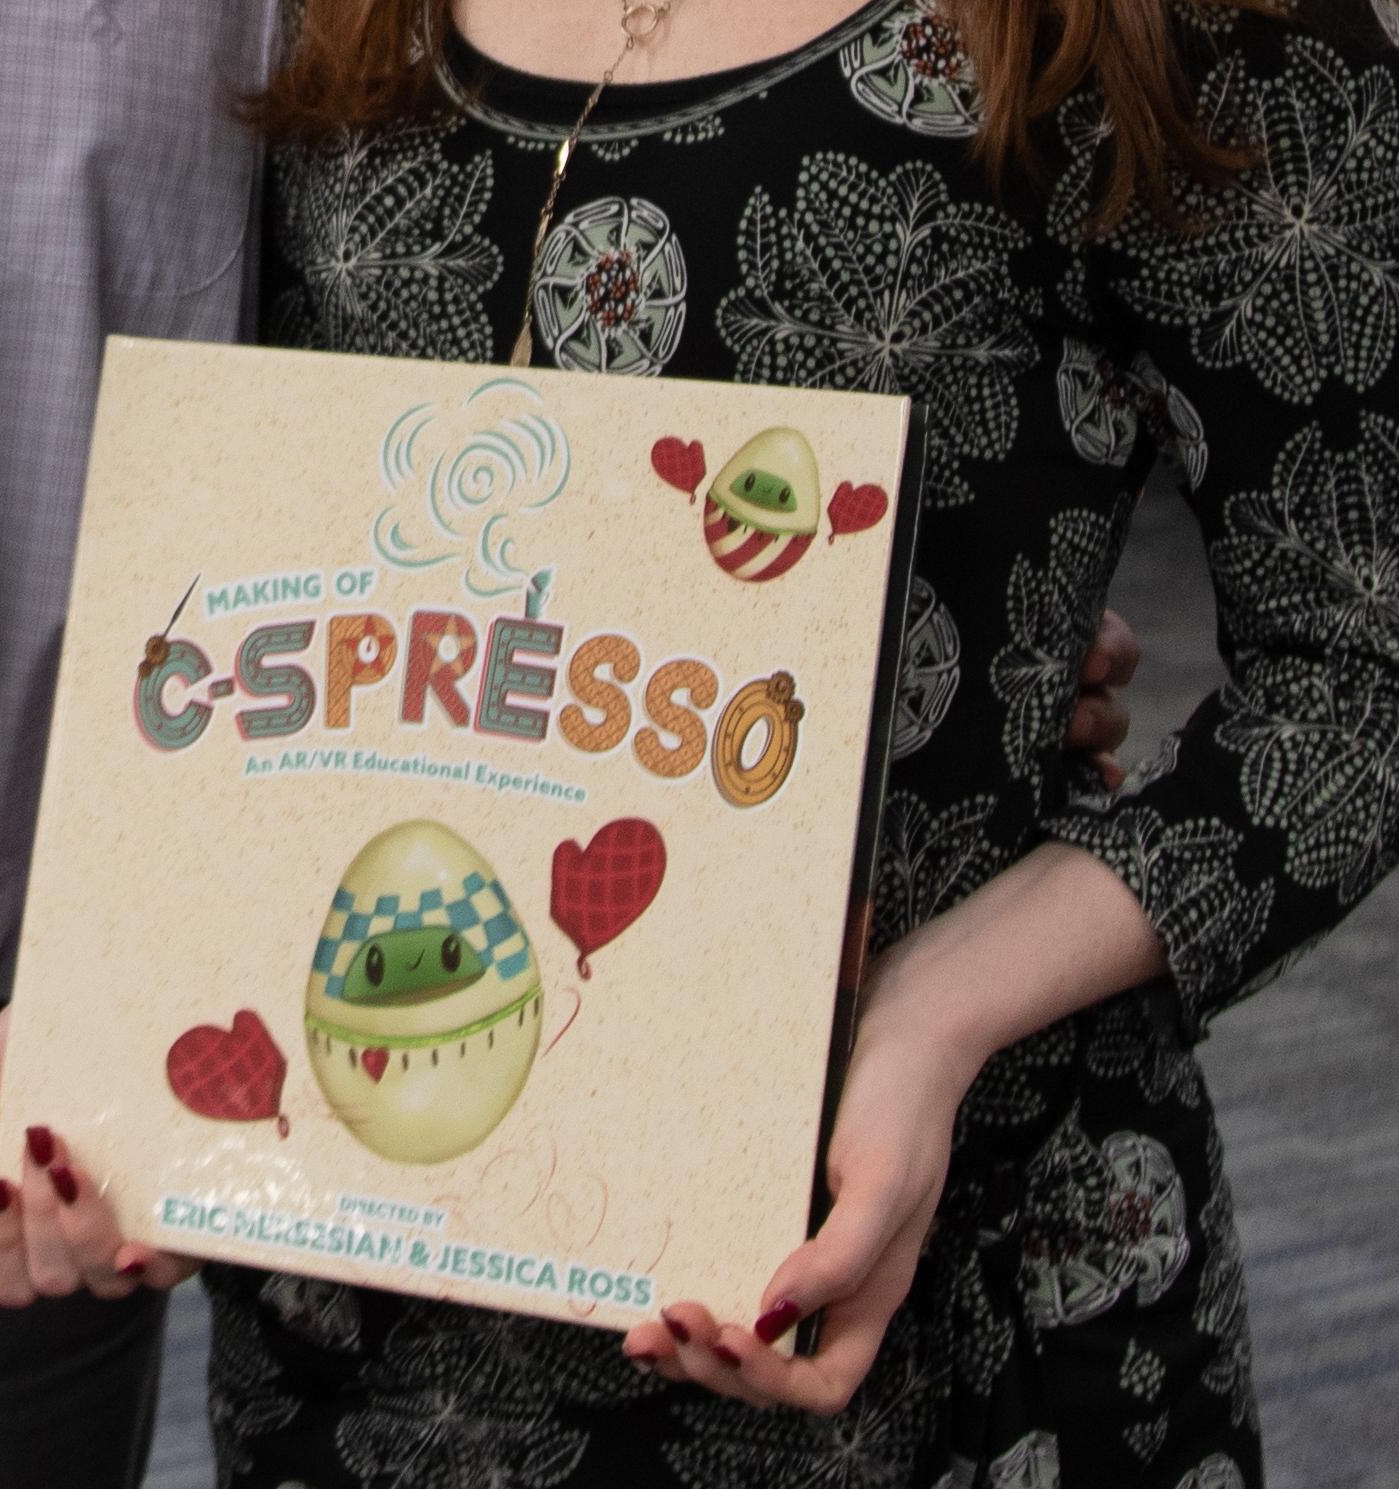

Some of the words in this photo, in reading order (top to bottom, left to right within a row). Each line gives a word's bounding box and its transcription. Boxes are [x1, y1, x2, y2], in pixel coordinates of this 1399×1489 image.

[207, 577, 321, 614] MAKING
[336, 572, 374, 597] OF
[135, 611, 804, 807] C-SPRESSO
[246, 757, 273, 775] An
[279, 751, 347, 770] AR/VR
[353, 752, 470, 780] Educational
[475, 764, 586, 802] Experience
[423, 1211, 445, 1226] BY
[162, 1198, 227, 1233] ERIC
[409, 1240, 430, 1268] &
[437, 1245, 557, 1291] JESSICA
[568, 1271, 652, 1304] ROSS
